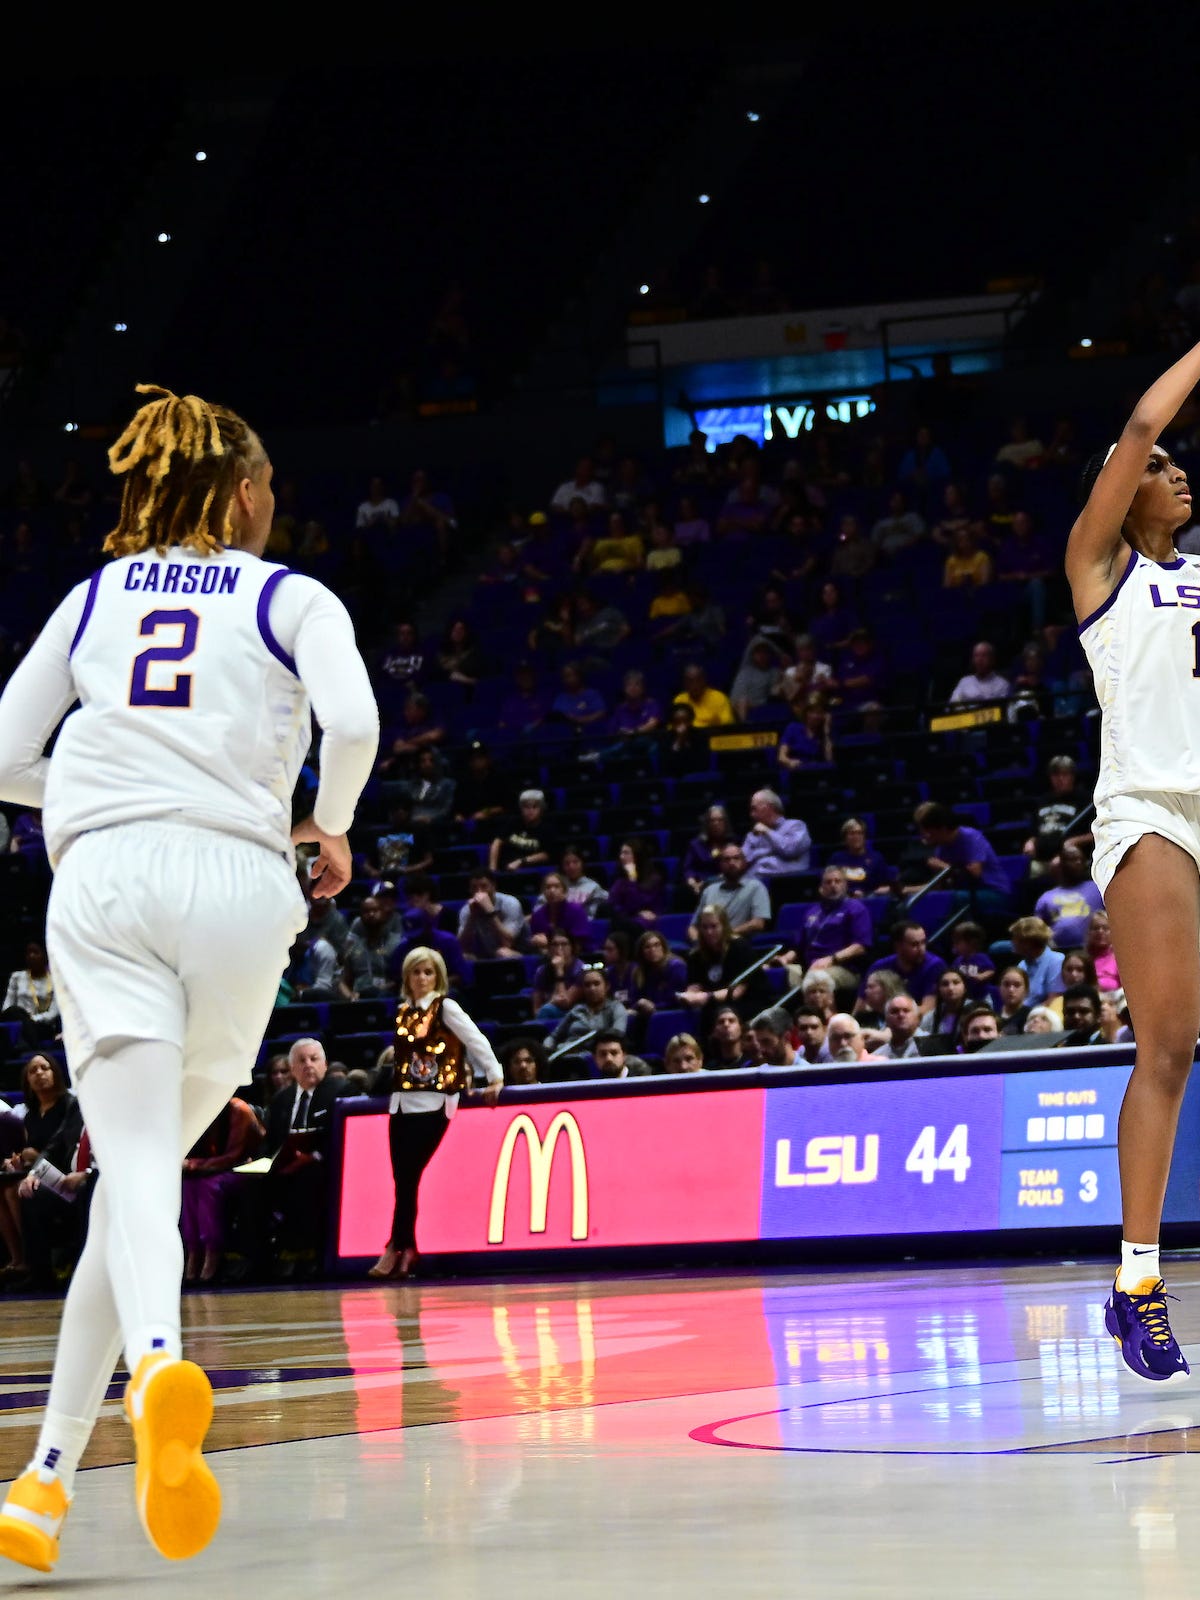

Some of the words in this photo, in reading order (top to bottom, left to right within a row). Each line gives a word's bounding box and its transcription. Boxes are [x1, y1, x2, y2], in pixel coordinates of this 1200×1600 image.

[124, 561, 241, 594] CARSON
[128, 607, 200, 709] 2
[1038, 1092, 1064, 1107] TIME
[1066, 1090, 1097, 1105] OUTS
[775, 1134, 880, 1187] LSU
[905, 1124, 971, 1184] 44
[1019, 1168, 1059, 1186] TEAM
[1078, 1170, 1099, 1203] 3
[1017, 1188, 1064, 1206] FOULS
